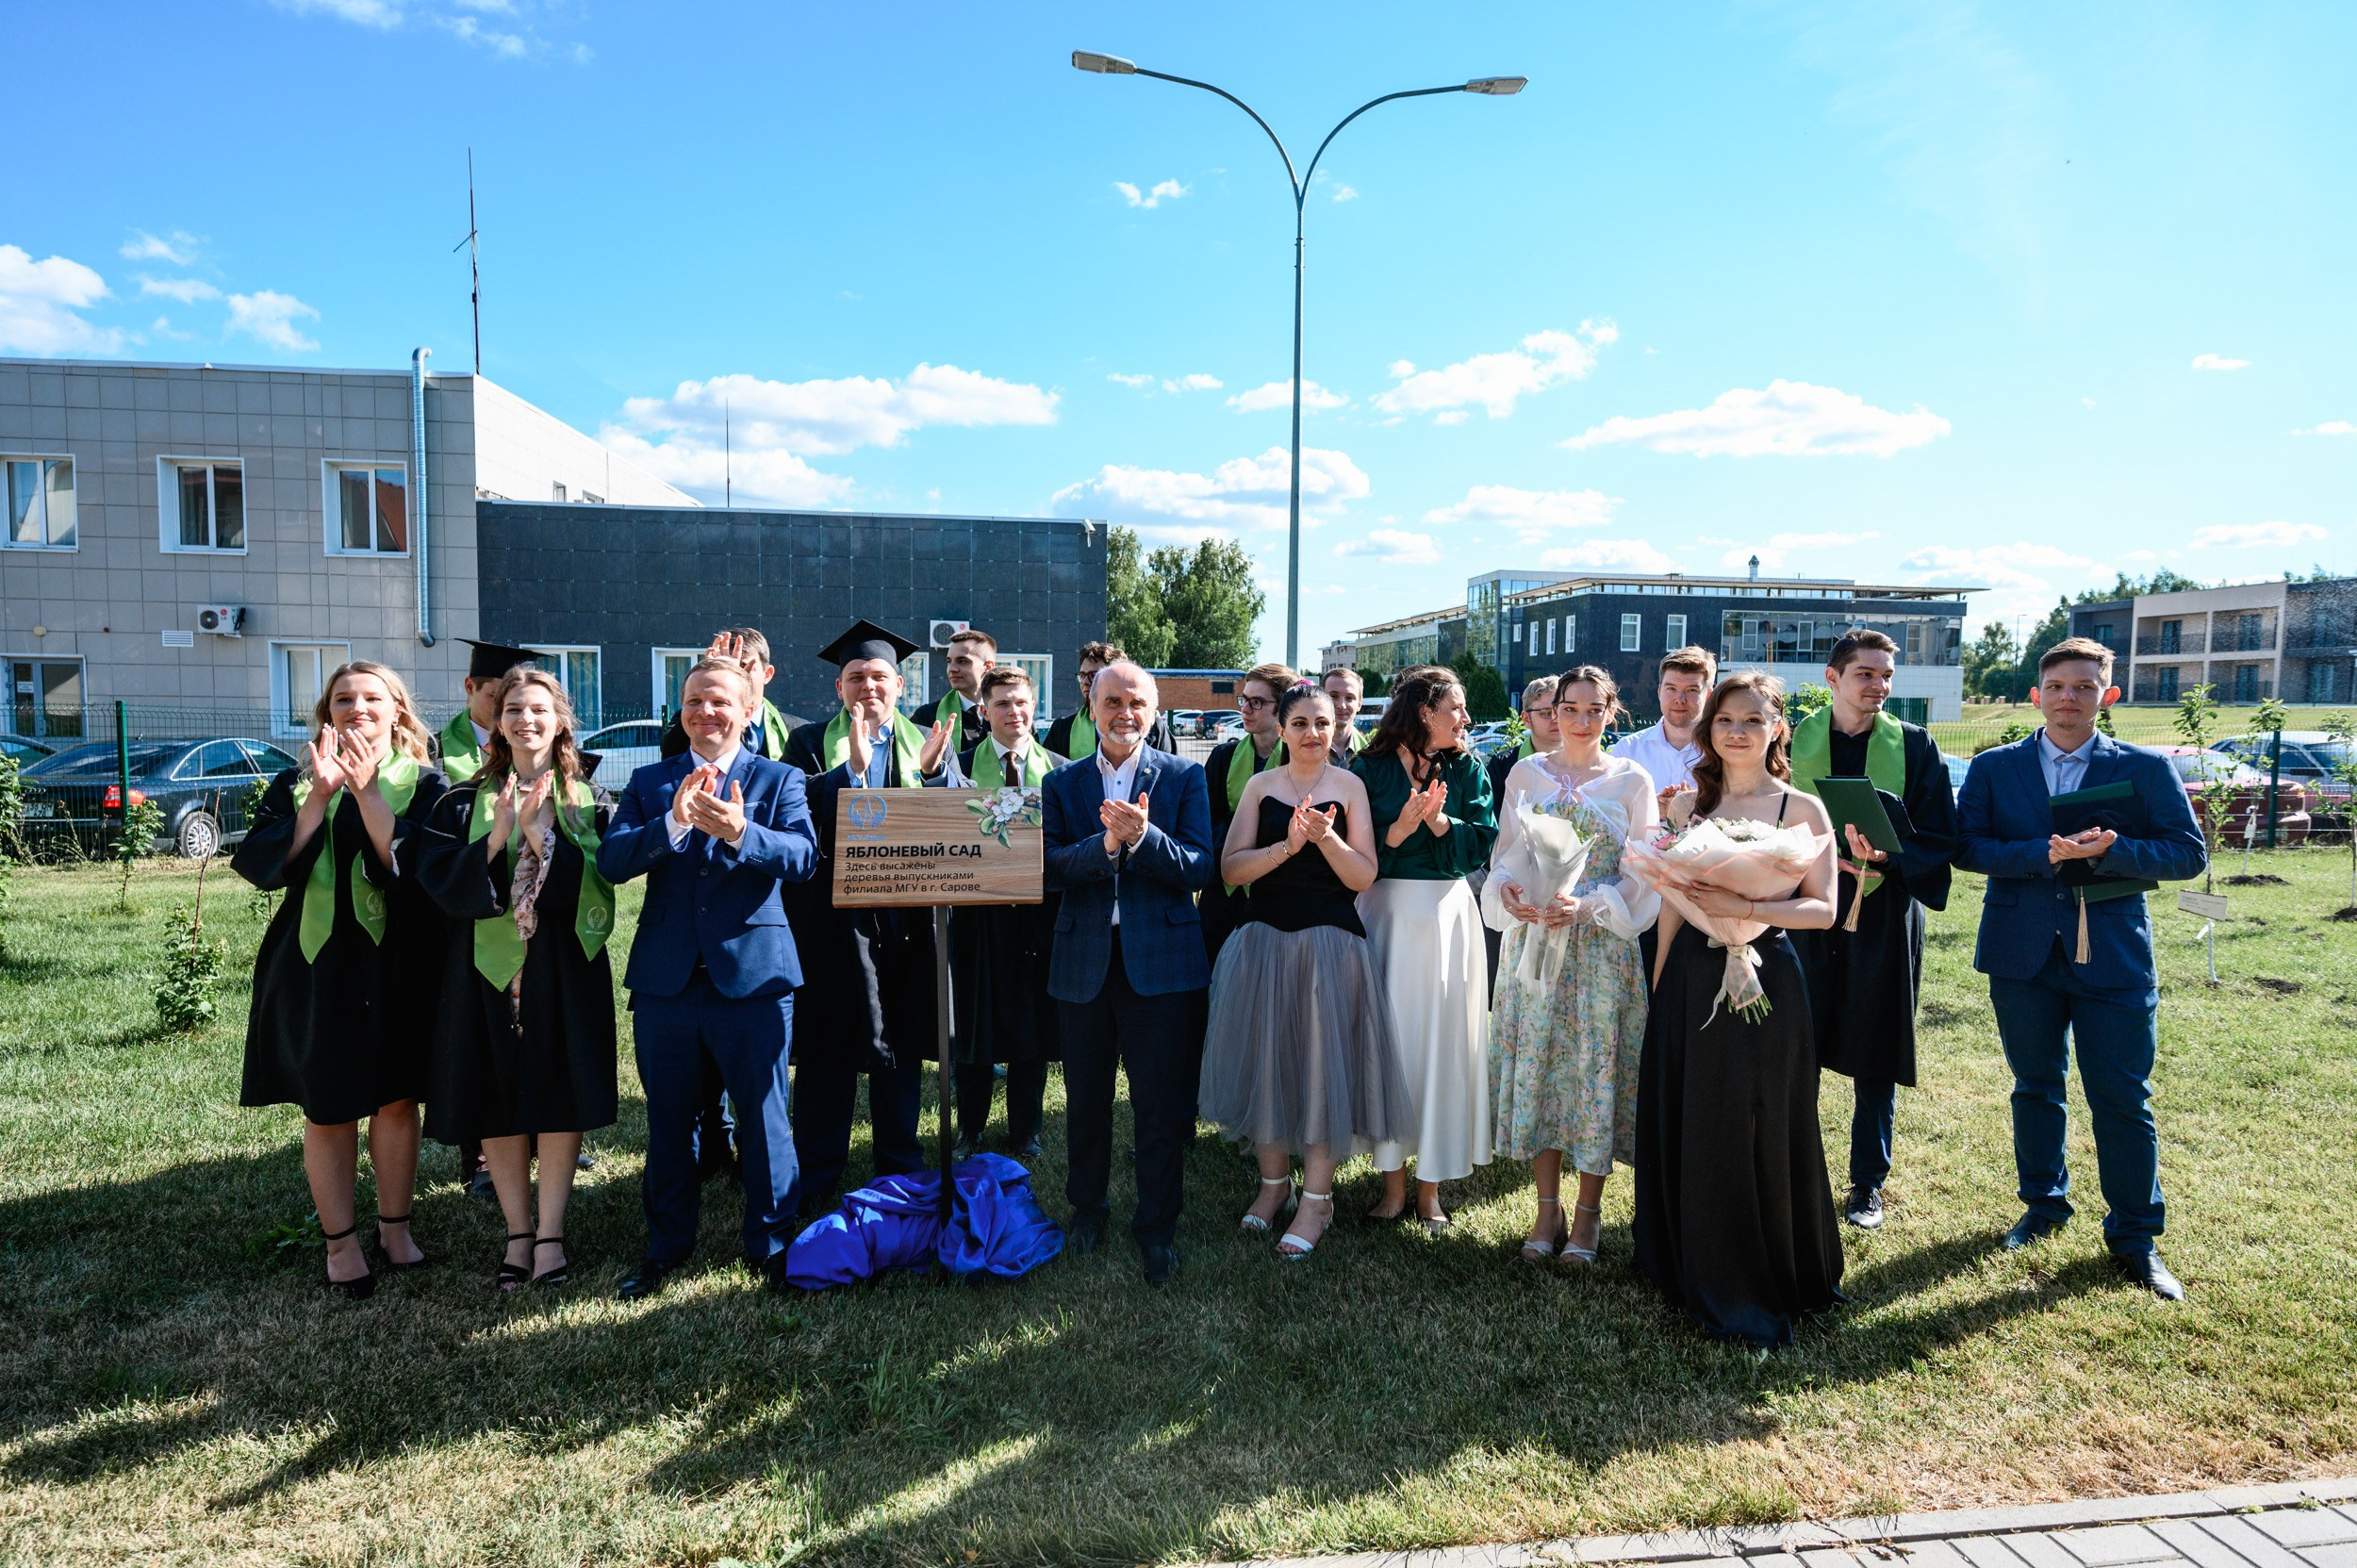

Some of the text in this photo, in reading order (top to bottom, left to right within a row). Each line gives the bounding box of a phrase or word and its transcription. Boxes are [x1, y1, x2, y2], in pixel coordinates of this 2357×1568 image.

[846, 842, 982, 858] ЯБЛОНЕВЫЙ САД
[845, 862, 877, 871] Здесь
[844, 872, 974, 883] деревья выпускниками
[843, 885, 893, 896] филиала
[895, 883, 918, 893] МГУ
[940, 883, 981, 893] Сарове
